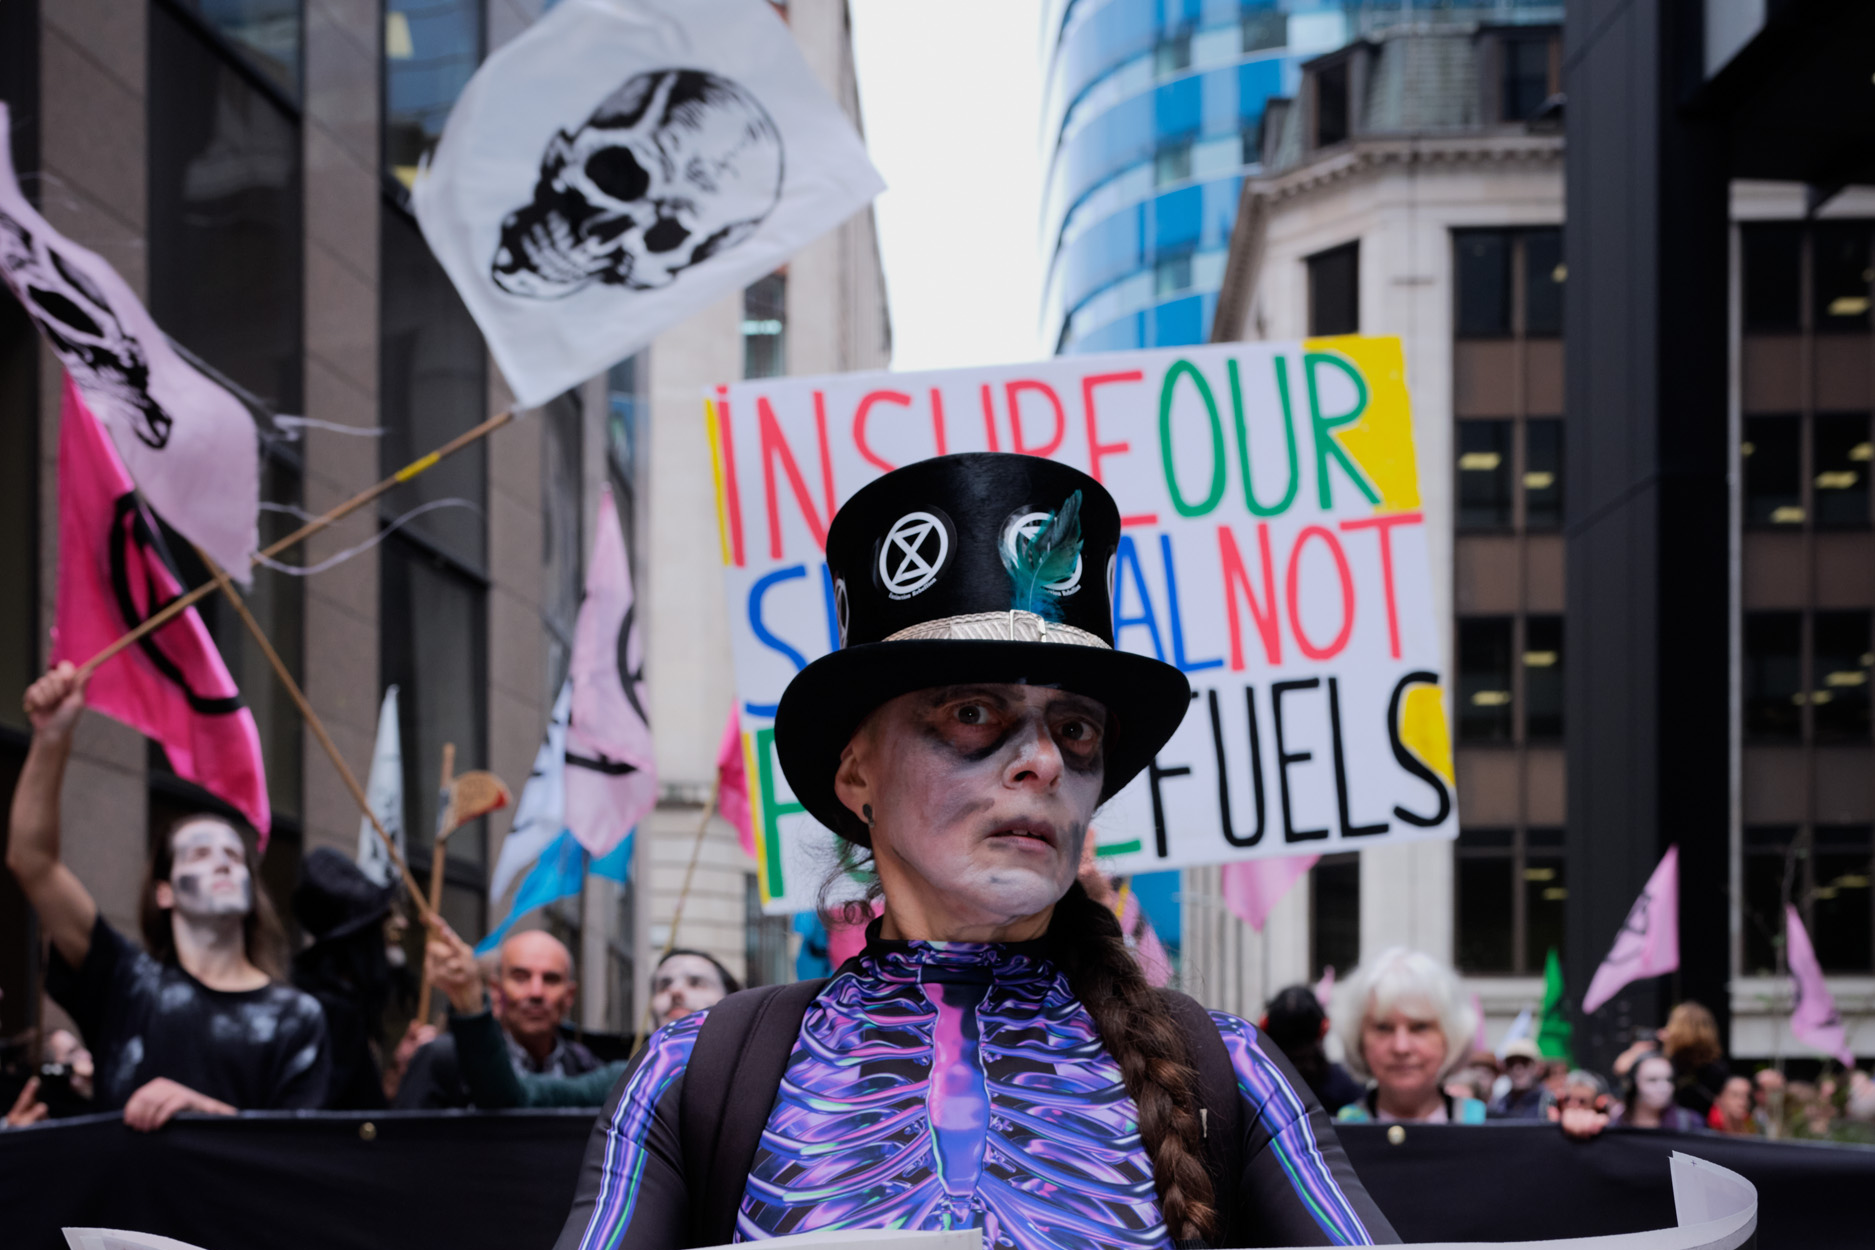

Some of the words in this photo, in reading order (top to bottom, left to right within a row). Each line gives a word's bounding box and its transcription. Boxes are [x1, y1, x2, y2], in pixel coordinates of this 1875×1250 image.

[1158, 350, 1381, 519] OUR
[1218, 512, 1424, 671] NOT
[1149, 671, 1451, 857] FUELS
